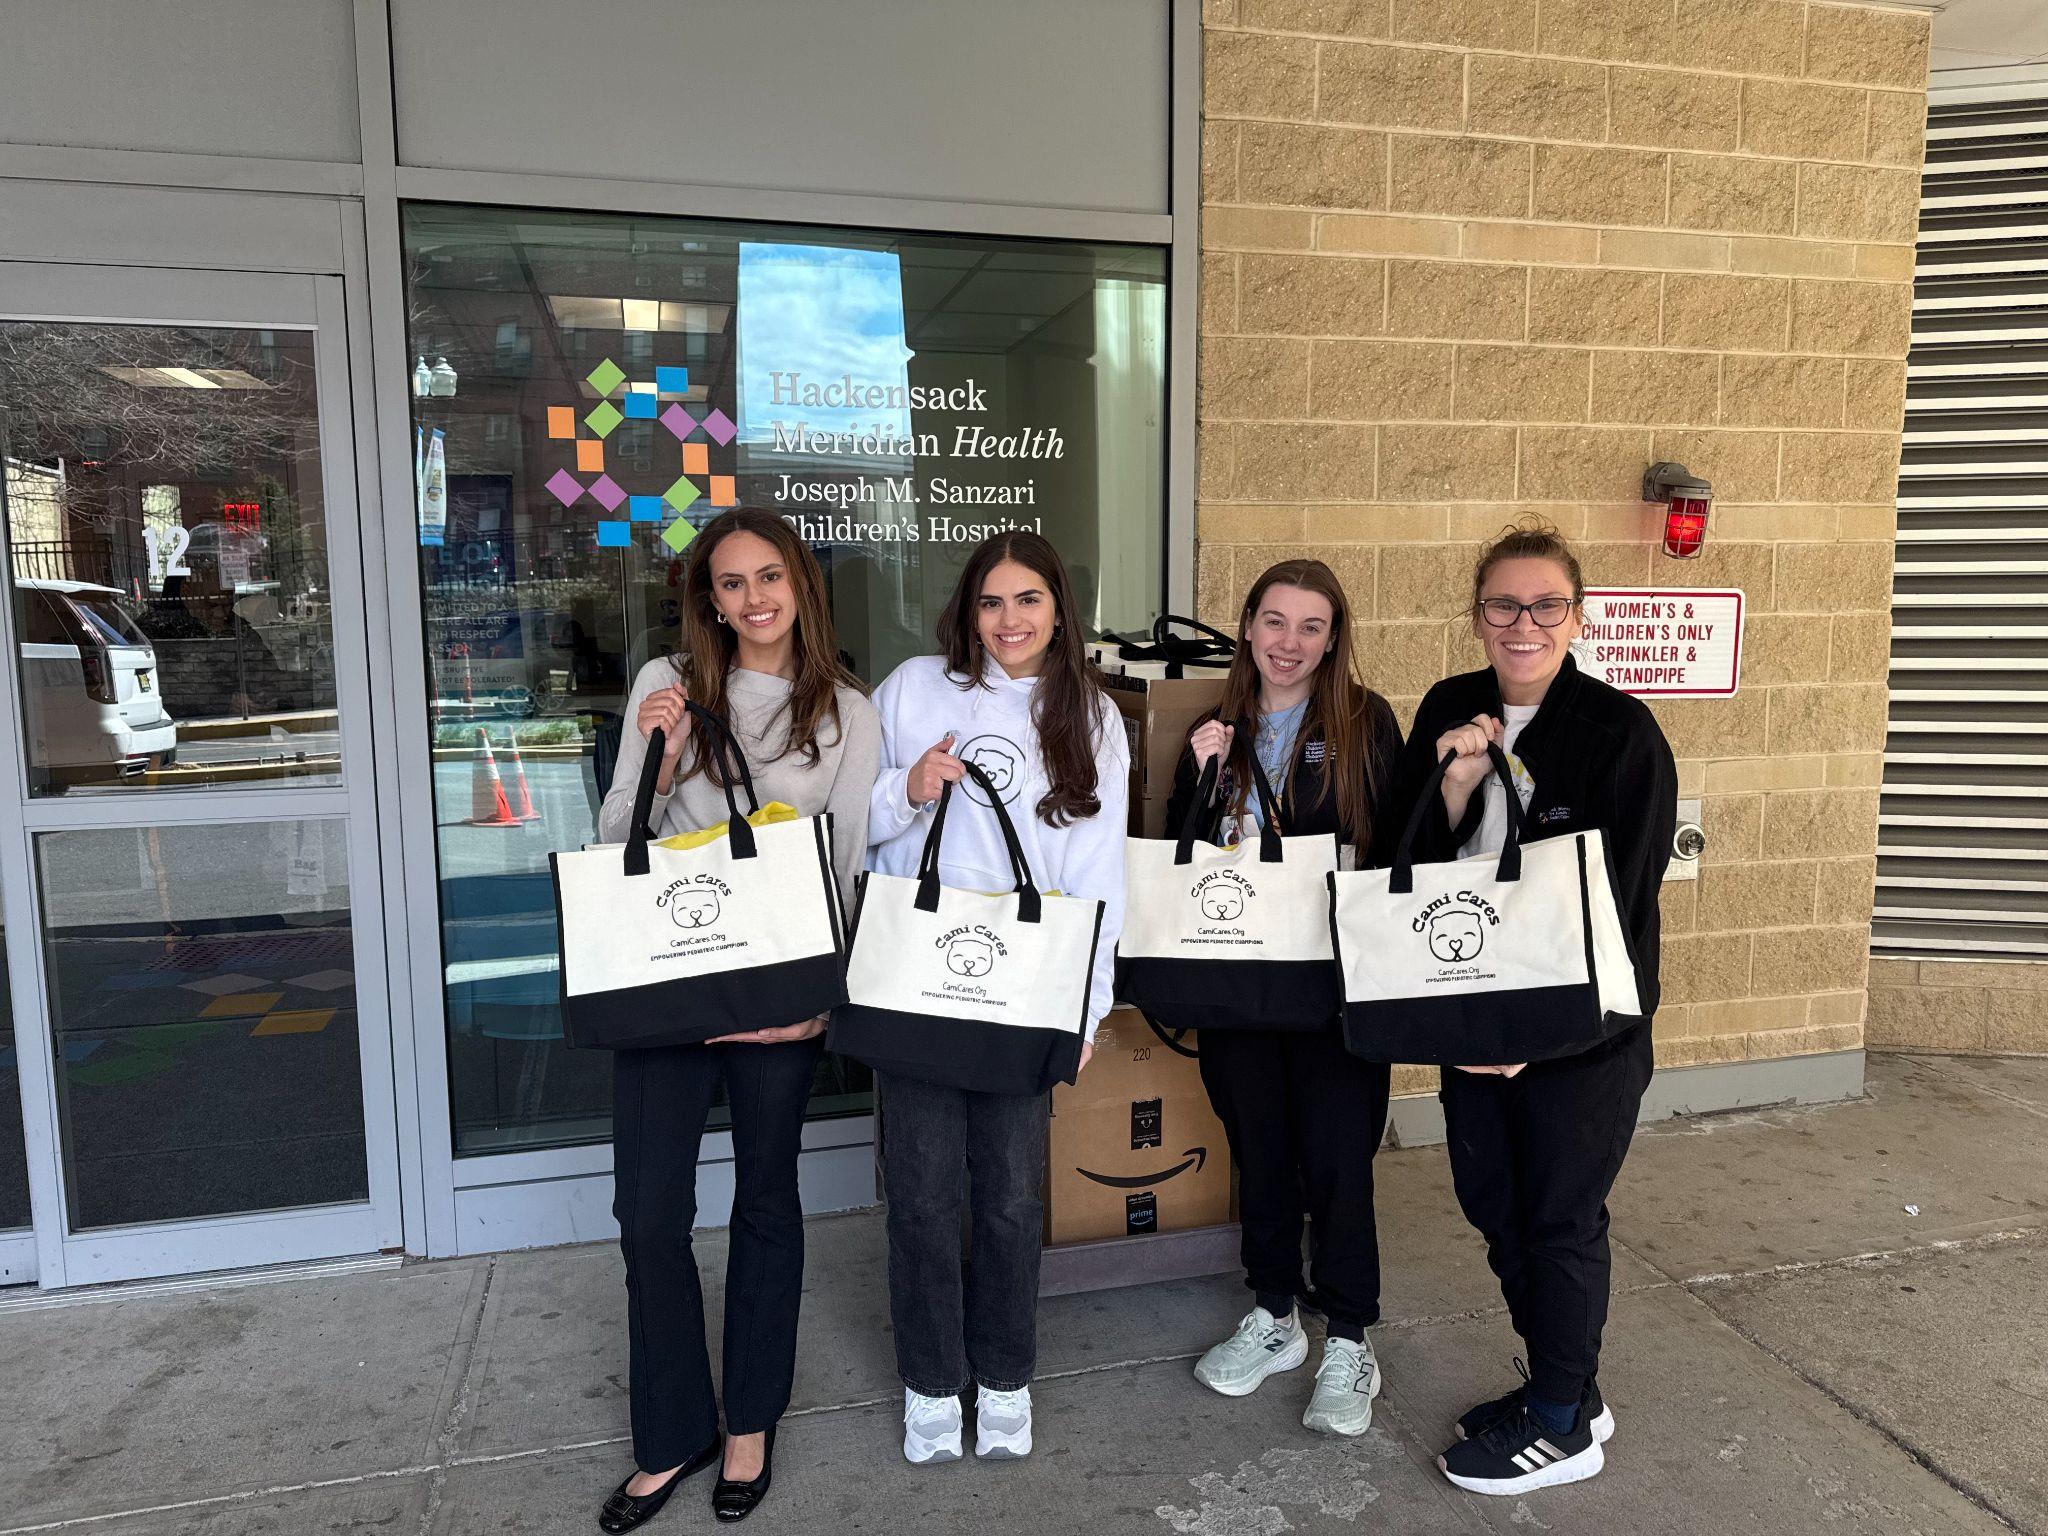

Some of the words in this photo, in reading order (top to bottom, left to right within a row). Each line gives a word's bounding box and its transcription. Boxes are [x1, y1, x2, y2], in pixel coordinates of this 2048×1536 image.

[769, 371, 988, 412] Hackensack
[770, 420, 941, 457] Meridian
[949, 426, 1065, 459] Health
[774, 474, 876, 509] Joseph
[884, 477, 921, 503] M.
[930, 477, 1036, 504] Sanzari
[224, 504, 261, 533] EXIT
[142, 526, 191, 576] 12
[1604, 602, 1676, 619] WOMEN'S
[1683, 603, 1694, 618] &
[451, 629, 501, 639] RESPECT
[1581, 624, 1670, 641] CHILDREN'S
[1677, 624, 1714, 641] ONLY
[1596, 646, 1679, 662] SPRINKLER
[1686, 646, 1697, 662] &
[1605, 667, 1686, 684] STANDPIPE
[656, 877, 691, 908] Cami
[694, 873, 732, 897] Cares
[1190, 870, 1219, 898] Cami
[1222, 869, 1256, 898] Cares
[1412, 893, 1451, 933] Cami
[1456, 890, 1500, 926] Cares
[935, 925, 971, 949] Cami
[974, 925, 1008, 956] Cares
[1133, 1048, 1151, 1062] 220
[1130, 1209, 1153, 1221] prime
